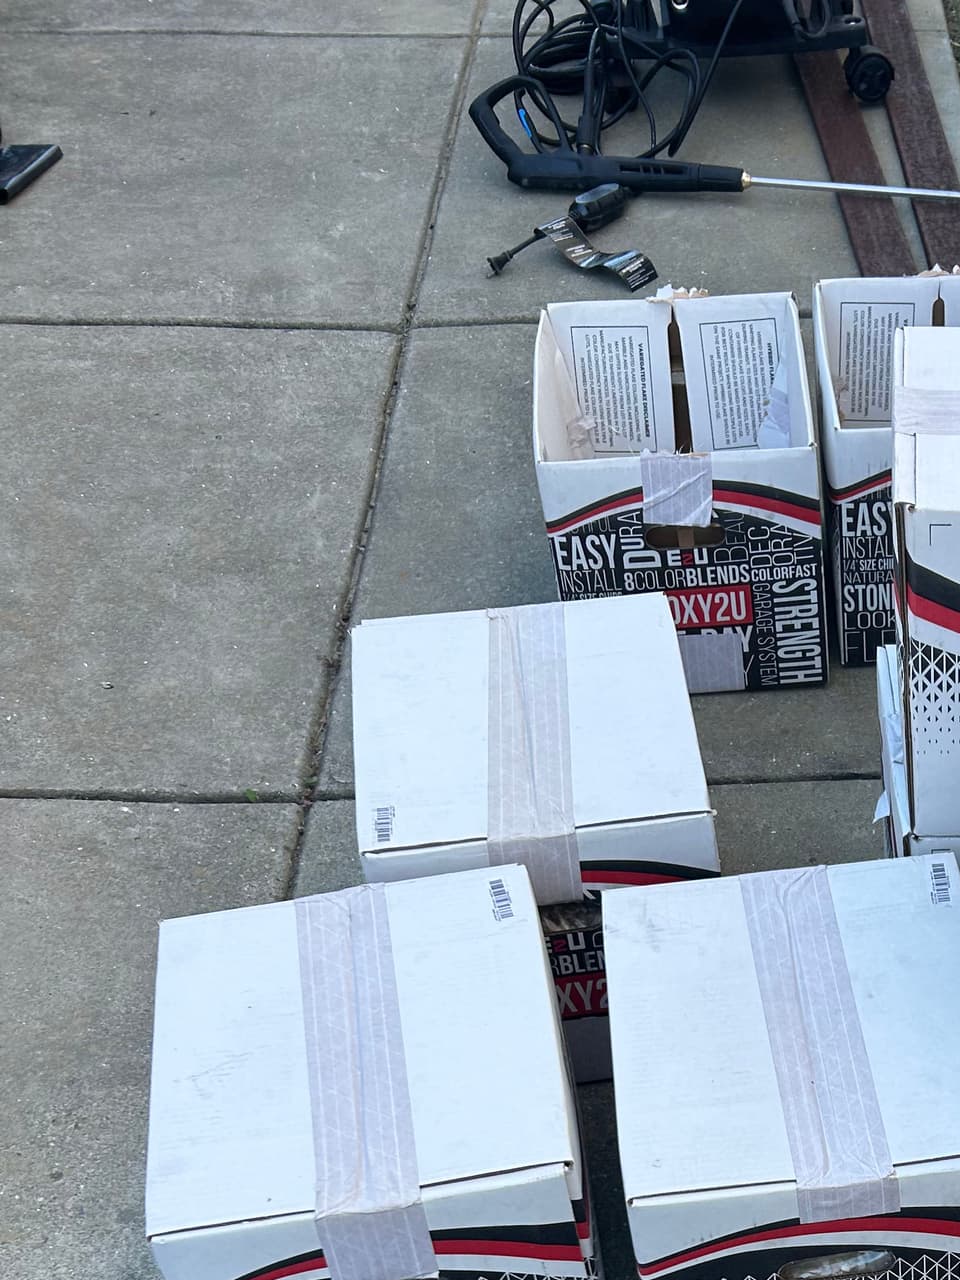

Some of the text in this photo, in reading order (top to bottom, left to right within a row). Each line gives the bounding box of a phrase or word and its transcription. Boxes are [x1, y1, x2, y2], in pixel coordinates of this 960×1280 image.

[554, 533, 617, 571] EASY
[842, 536, 895, 559] INSTAL
[751, 562, 818, 582] COLORFAST
[859, 559, 877, 571] SIZE
[560, 568, 623, 593] INSTALL
[843, 570, 895, 584] NATURA
[771, 578, 823, 685] STRENGTH
[844, 610, 896, 630] LOOK
[752, 582, 779, 686] GARAGE SYSTEM
